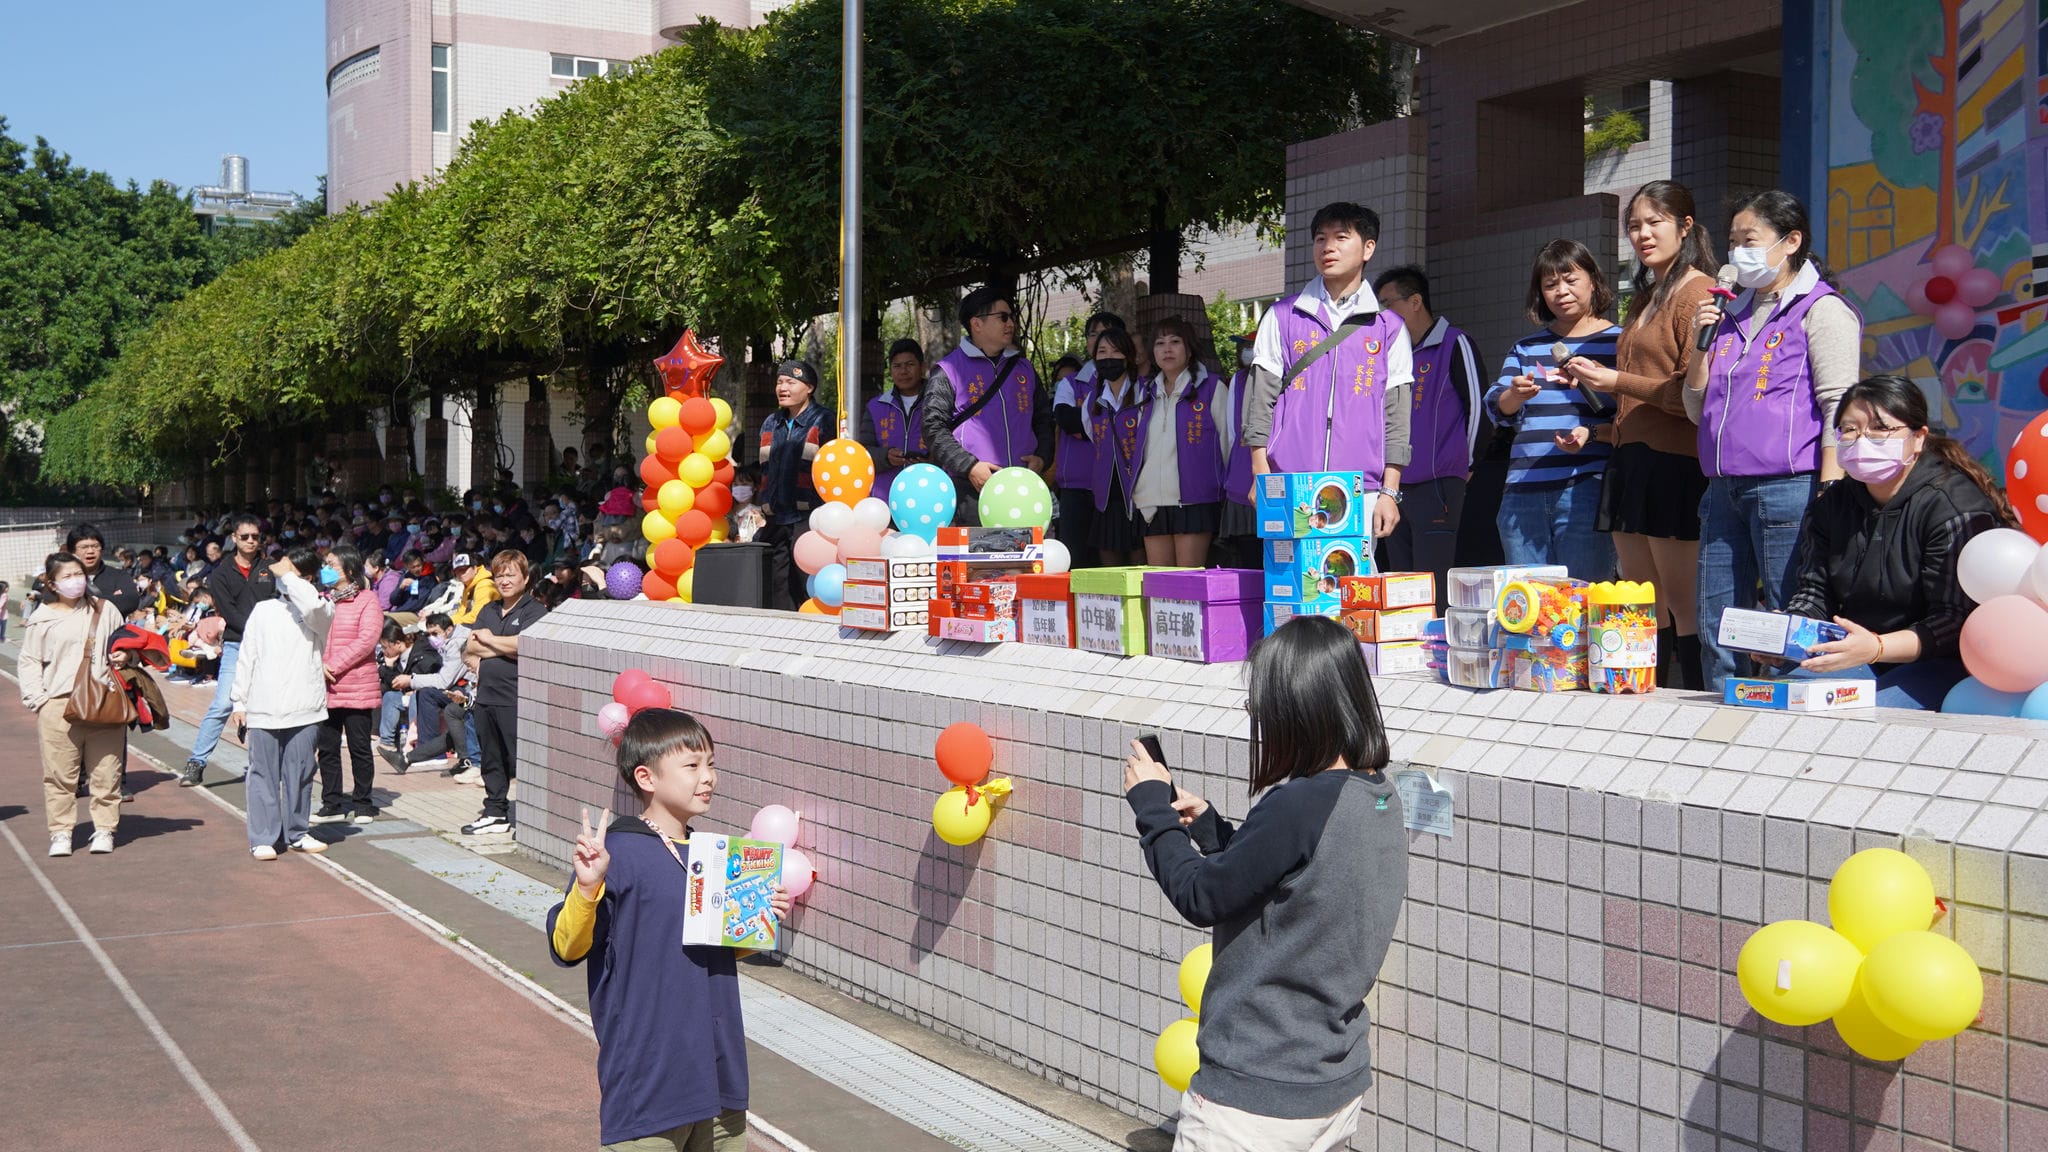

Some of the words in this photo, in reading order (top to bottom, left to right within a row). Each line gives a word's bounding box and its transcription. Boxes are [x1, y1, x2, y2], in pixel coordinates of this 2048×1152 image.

[1753, 351, 1773, 401] 祥安國小
[1026, 546, 1037, 559] 7
[1033, 617, 1057, 633] 低年級
[1081, 605, 1117, 633] 中年級
[1155, 610, 1196, 637] 高年級
[743, 846, 774, 861] FRUIT
[741, 858, 775, 872] STICKING
